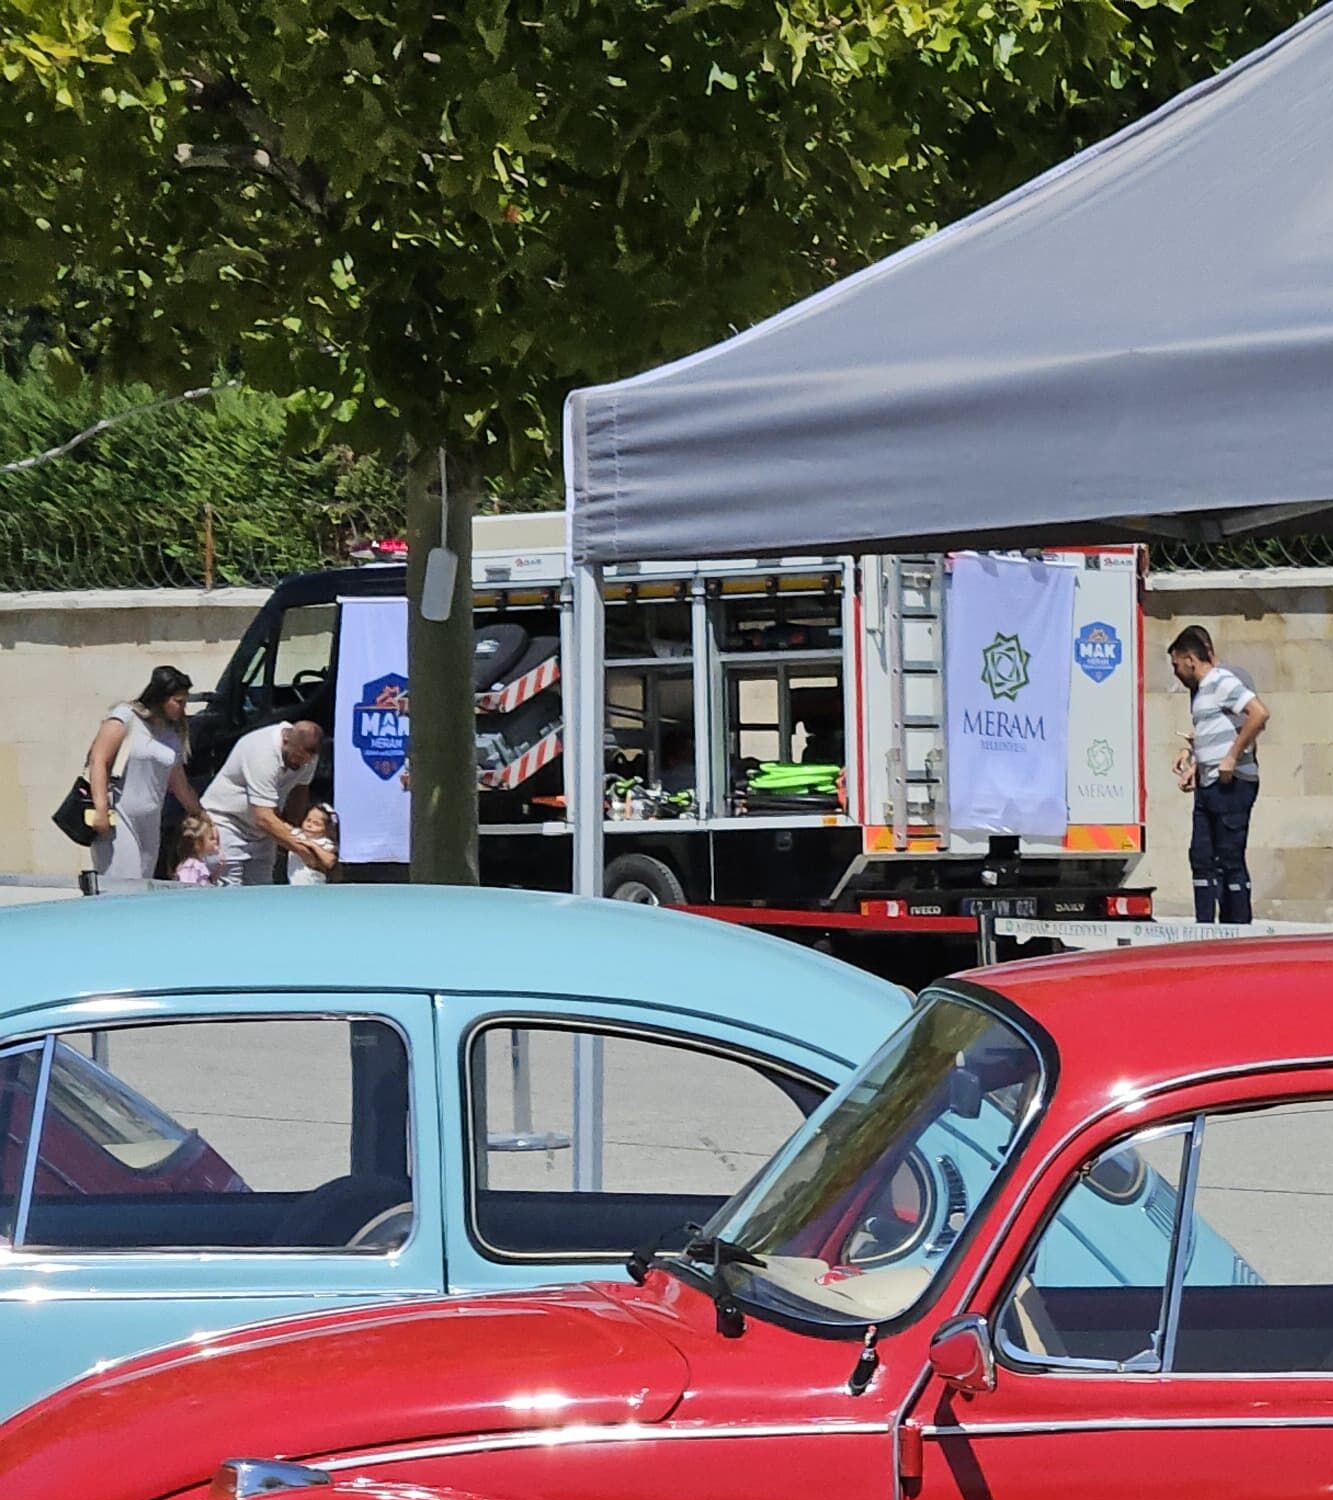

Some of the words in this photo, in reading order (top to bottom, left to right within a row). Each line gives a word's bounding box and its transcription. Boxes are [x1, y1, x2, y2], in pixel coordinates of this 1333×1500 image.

[1080, 642, 1116, 659] MAK
[962, 708, 1046, 742] MERAM
[910, 904, 942, 916] IVECO
[1055, 902, 1085, 913] DAILY
